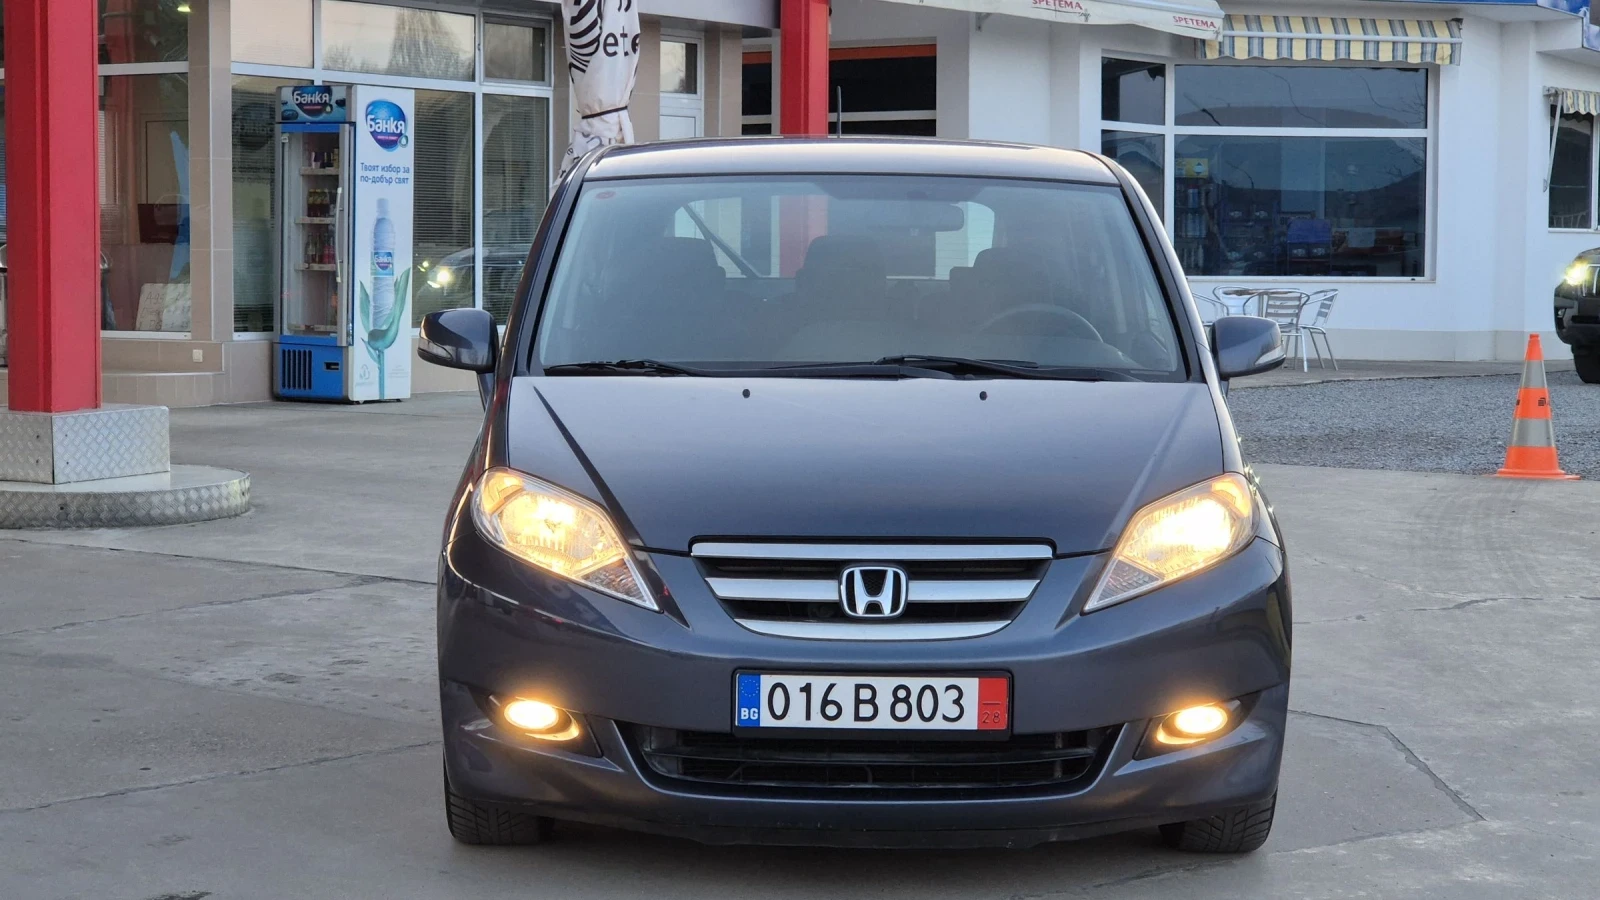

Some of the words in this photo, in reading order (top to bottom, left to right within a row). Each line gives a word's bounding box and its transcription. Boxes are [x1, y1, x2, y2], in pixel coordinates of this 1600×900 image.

[1172, 15, 1217, 29] SPETEMA
[360, 162, 380, 172] Твоят
[381, 163, 401, 175] избор
[402, 166, 410, 174] за
[360, 174, 393, 186] по-добър
[394, 176, 409, 185] свят
[740, 707, 759, 720] BG
[981, 711, 1001, 725] 28
